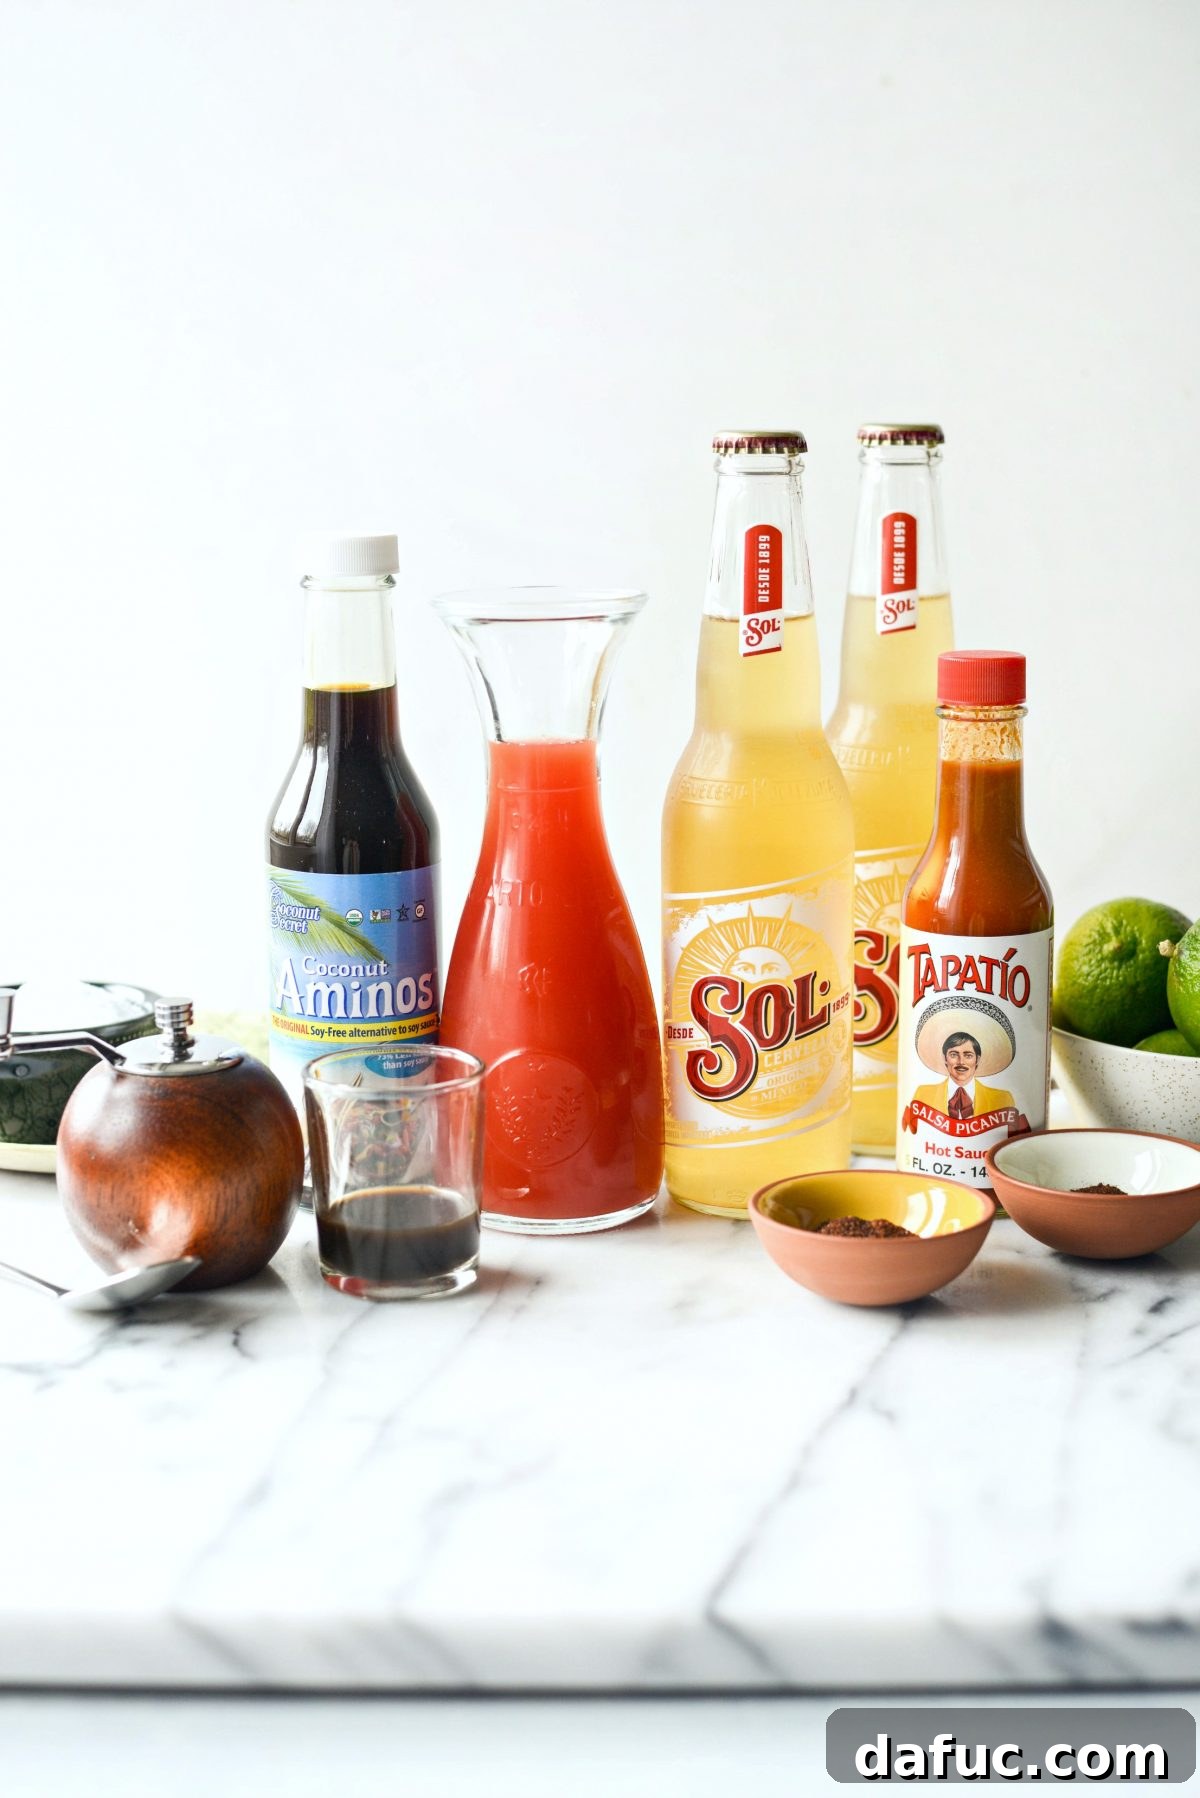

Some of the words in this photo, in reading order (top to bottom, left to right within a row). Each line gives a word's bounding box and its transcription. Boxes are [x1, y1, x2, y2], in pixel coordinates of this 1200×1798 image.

[758, 535, 770, 564] 1899
[757, 567, 770, 603] DESDE
[303, 955, 389, 977] Coconut
[907, 942, 1032, 1009] TAPATÍO
[276, 957, 434, 1019] Aminos
[832, 991, 850, 1013] 1899
[280, 1018, 310, 1035] ORIGINAL
[310, 1025, 347, 1038] Soy-Free
[348, 1026, 398, 1038] alternative
[398, 1025, 407, 1034] to
[407, 1022, 420, 1034] soy
[667, 1025, 694, 1039] DESDE
[686, 970, 831, 1102] SOL
[383, 1061, 402, 1070] than
[912, 1102, 950, 1133] SALSA
[955, 1110, 1017, 1135] PICANTE
[925, 1141, 951, 1158] Hot
[954, 1146, 989, 1160] Sauc
[912, 1156, 929, 1172] FL.
[932, 1162, 956, 1177] OZ.
[970, 1166, 990, 1178] 14
